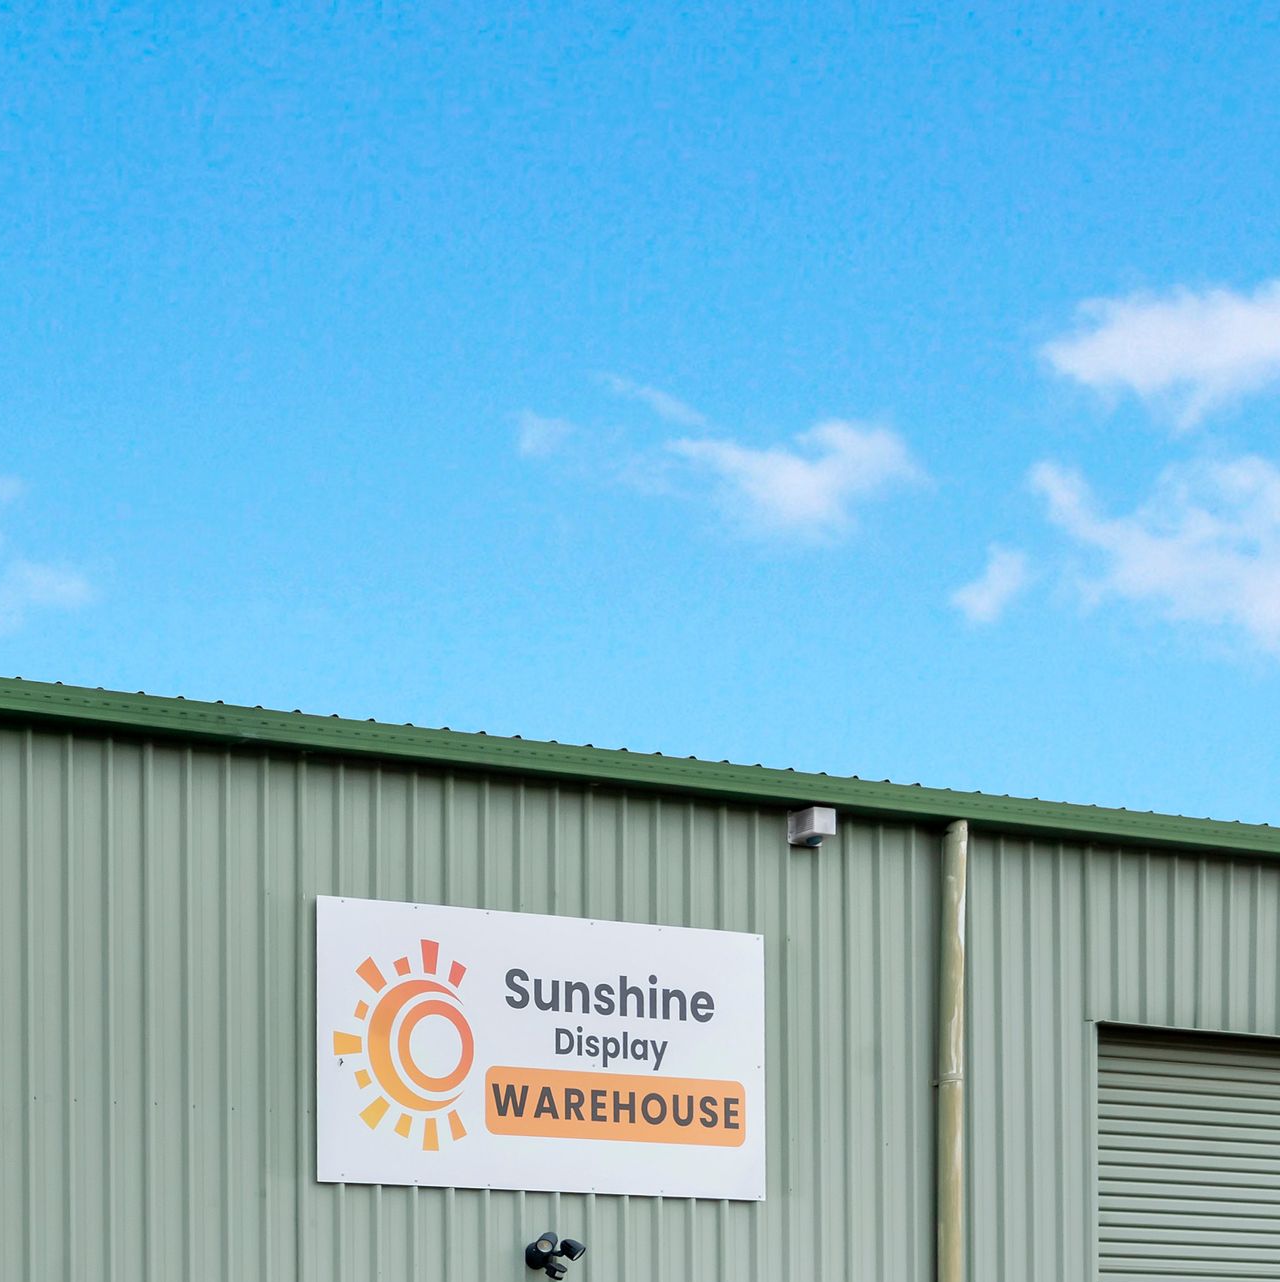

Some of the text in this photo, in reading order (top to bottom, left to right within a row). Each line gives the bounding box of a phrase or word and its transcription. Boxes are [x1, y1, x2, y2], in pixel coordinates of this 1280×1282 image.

[504, 968, 715, 1023] Sunshine
[554, 1026, 669, 1071] Display
[491, 1083, 740, 1130] WAREHOUSE
